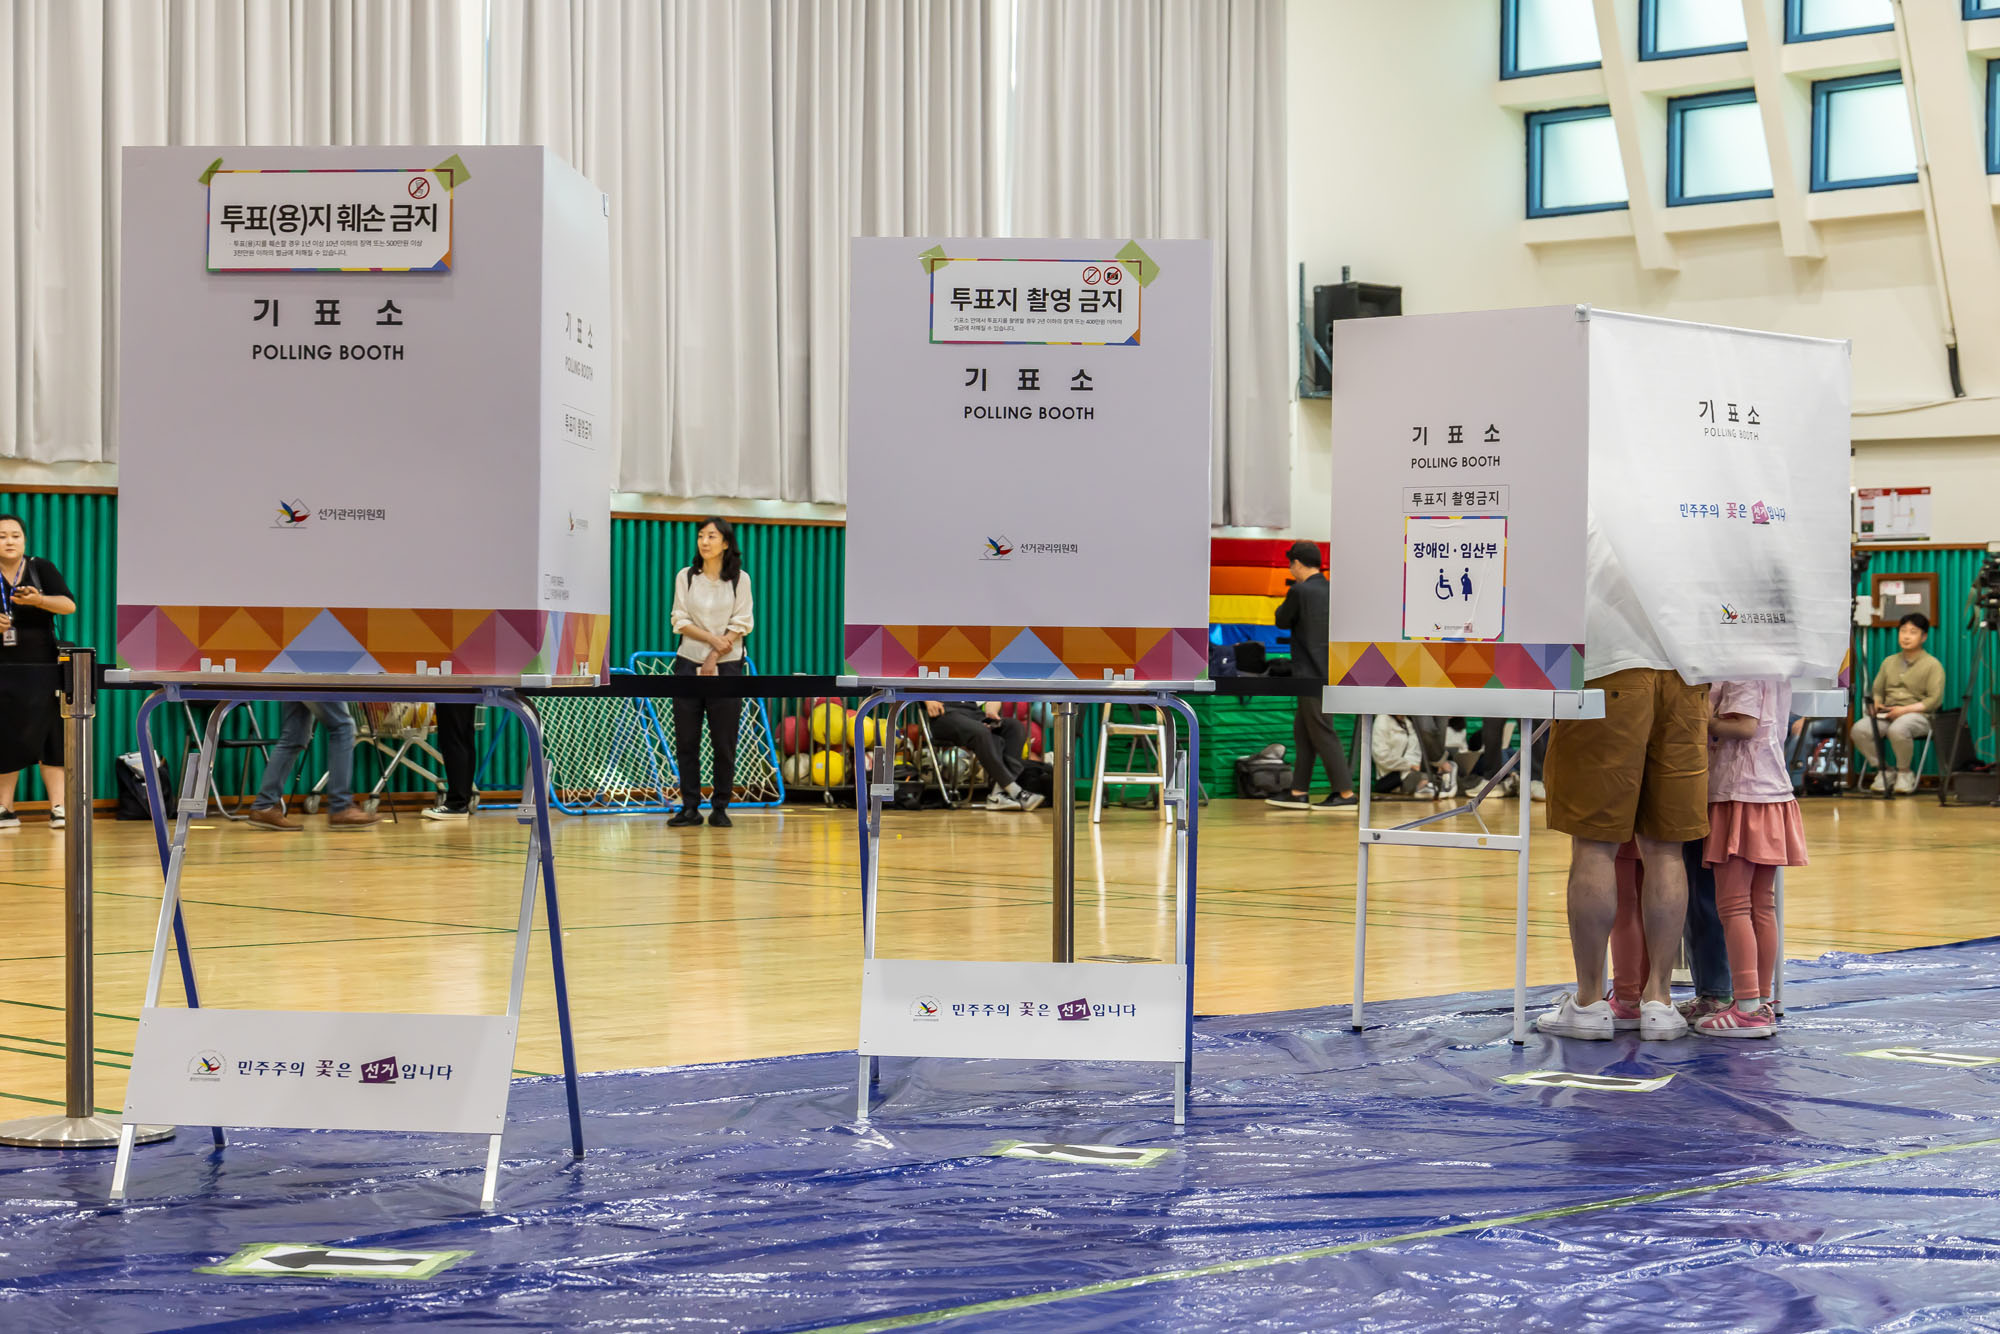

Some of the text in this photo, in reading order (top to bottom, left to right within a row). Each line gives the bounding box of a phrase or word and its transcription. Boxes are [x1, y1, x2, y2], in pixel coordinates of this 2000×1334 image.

[221, 203, 437, 236] 투표(용)지 훼손 금지
[951, 288, 1122, 313] 투표지 촬영 금지
[253, 345, 403, 360] POLLING BOOTH
[965, 406, 1094, 419] POLLING BOOTH
[1704, 428, 1759, 440] POLLING BOOTH
[1412, 456, 1500, 468] POLLING BOOTH
[1412, 491, 1499, 507] 투표지 촬영금지
[318, 509, 385, 520] 선거관리위원회
[1680, 504, 1719, 518] 민주주의
[1726, 503, 1747, 518] 꽃은
[1020, 544, 1077, 553] 선거관리위원회
[952, 1003, 1010, 1017] 민주주의
[1019, 1002, 1050, 1016] 꽃은
[1059, 1001, 1136, 1018] 선거입니다
[238, 1060, 304, 1077] 민주주의
[316, 1060, 352, 1077] 꽃은
[362, 1060, 452, 1081] 선거입니다
